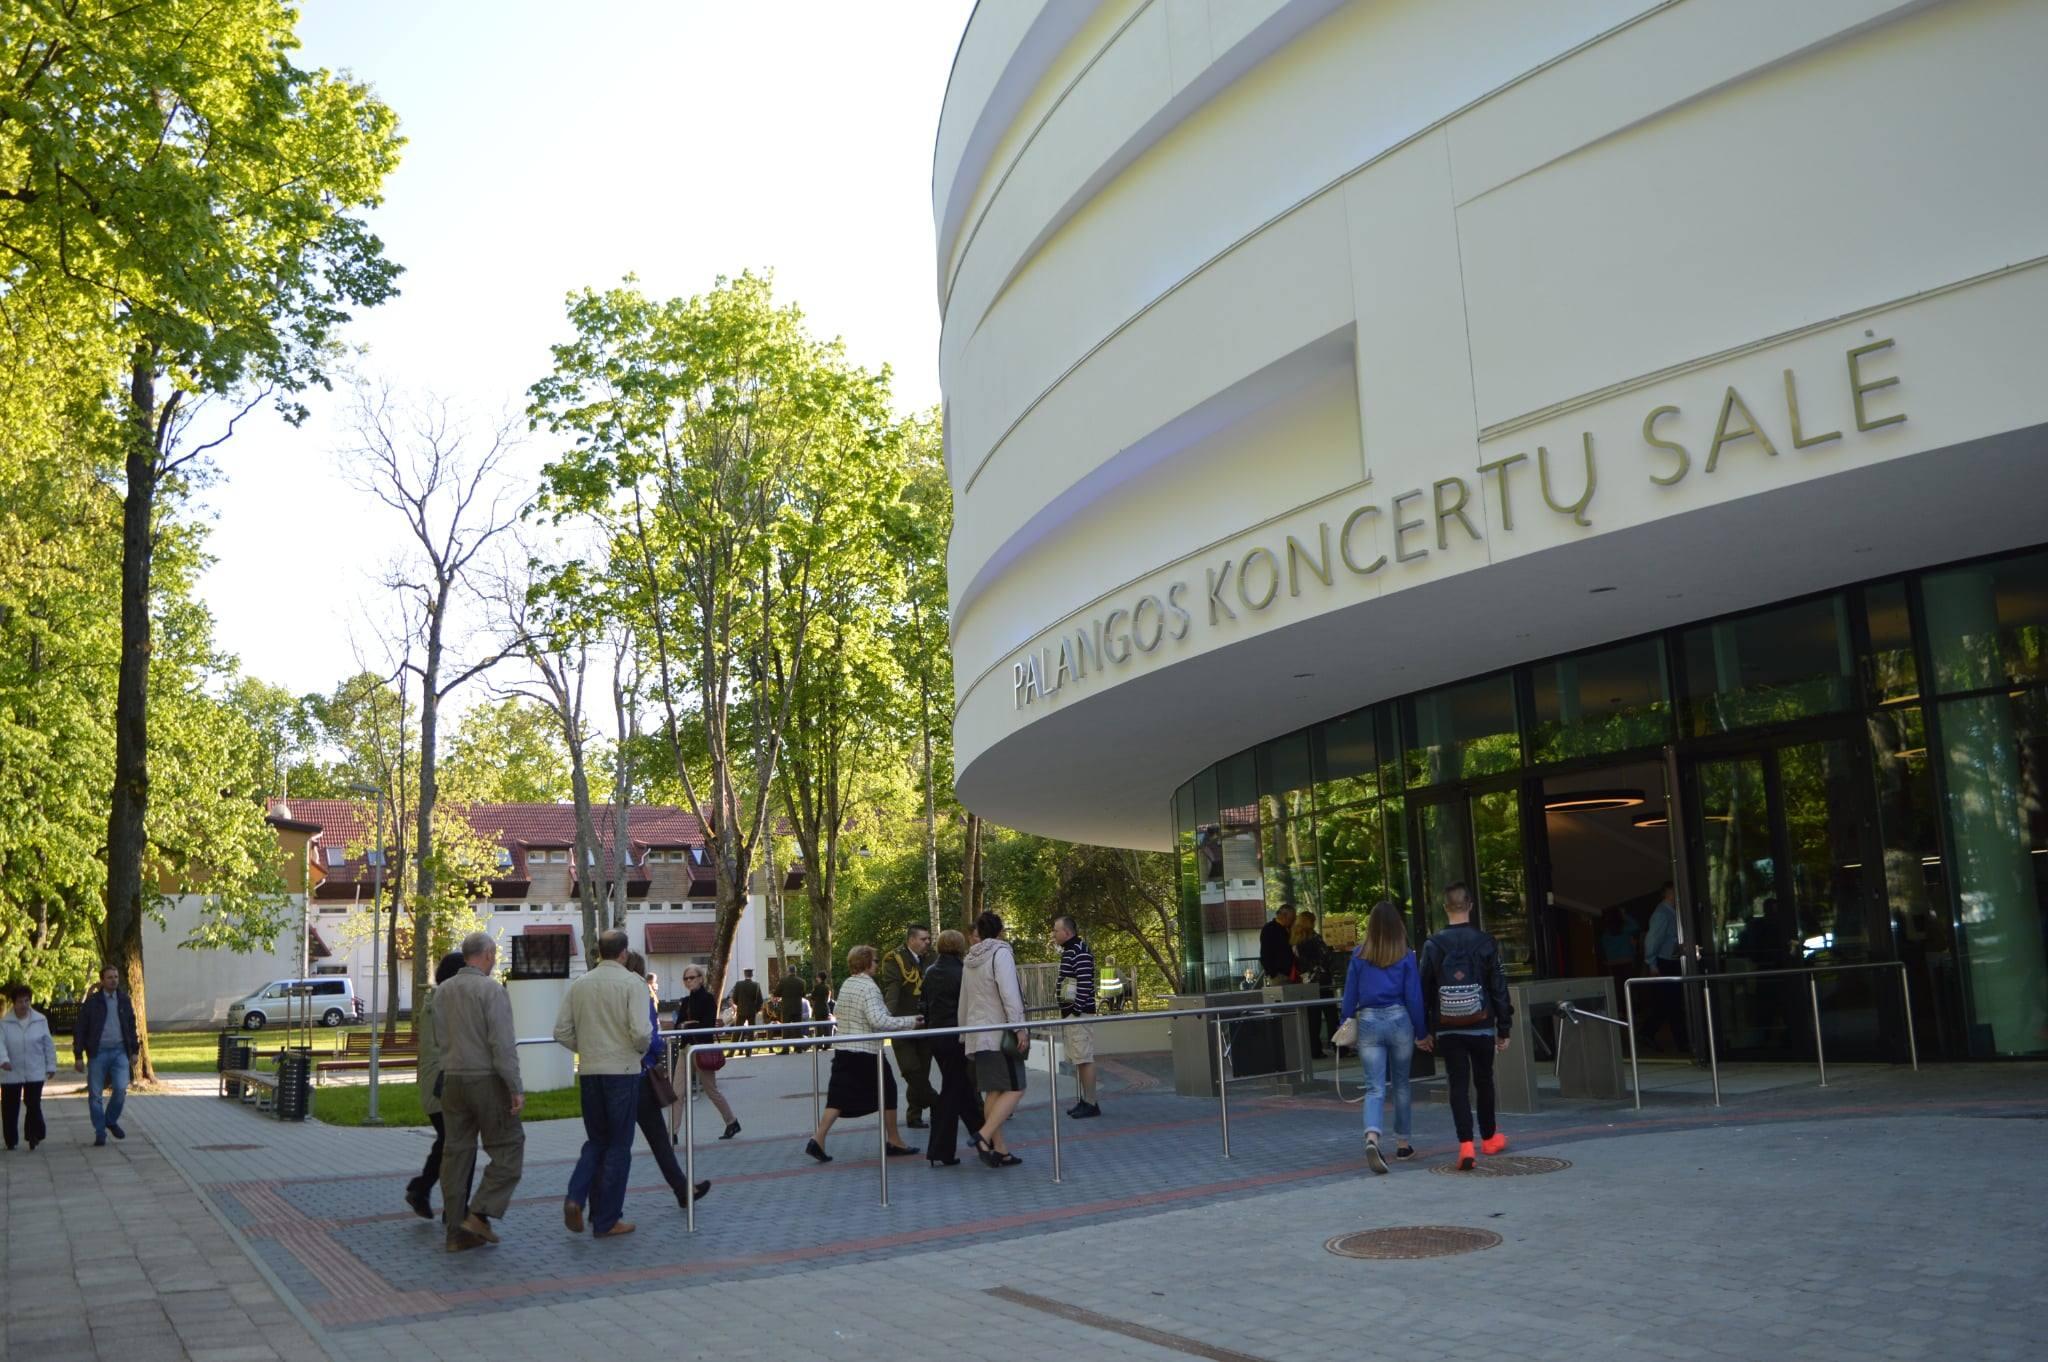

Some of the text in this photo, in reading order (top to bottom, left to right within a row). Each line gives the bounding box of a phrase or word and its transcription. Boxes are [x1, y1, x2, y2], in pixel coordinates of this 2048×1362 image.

[1013, 329, 1907, 710] PALANGOS KONCERTŲ SALĖ
